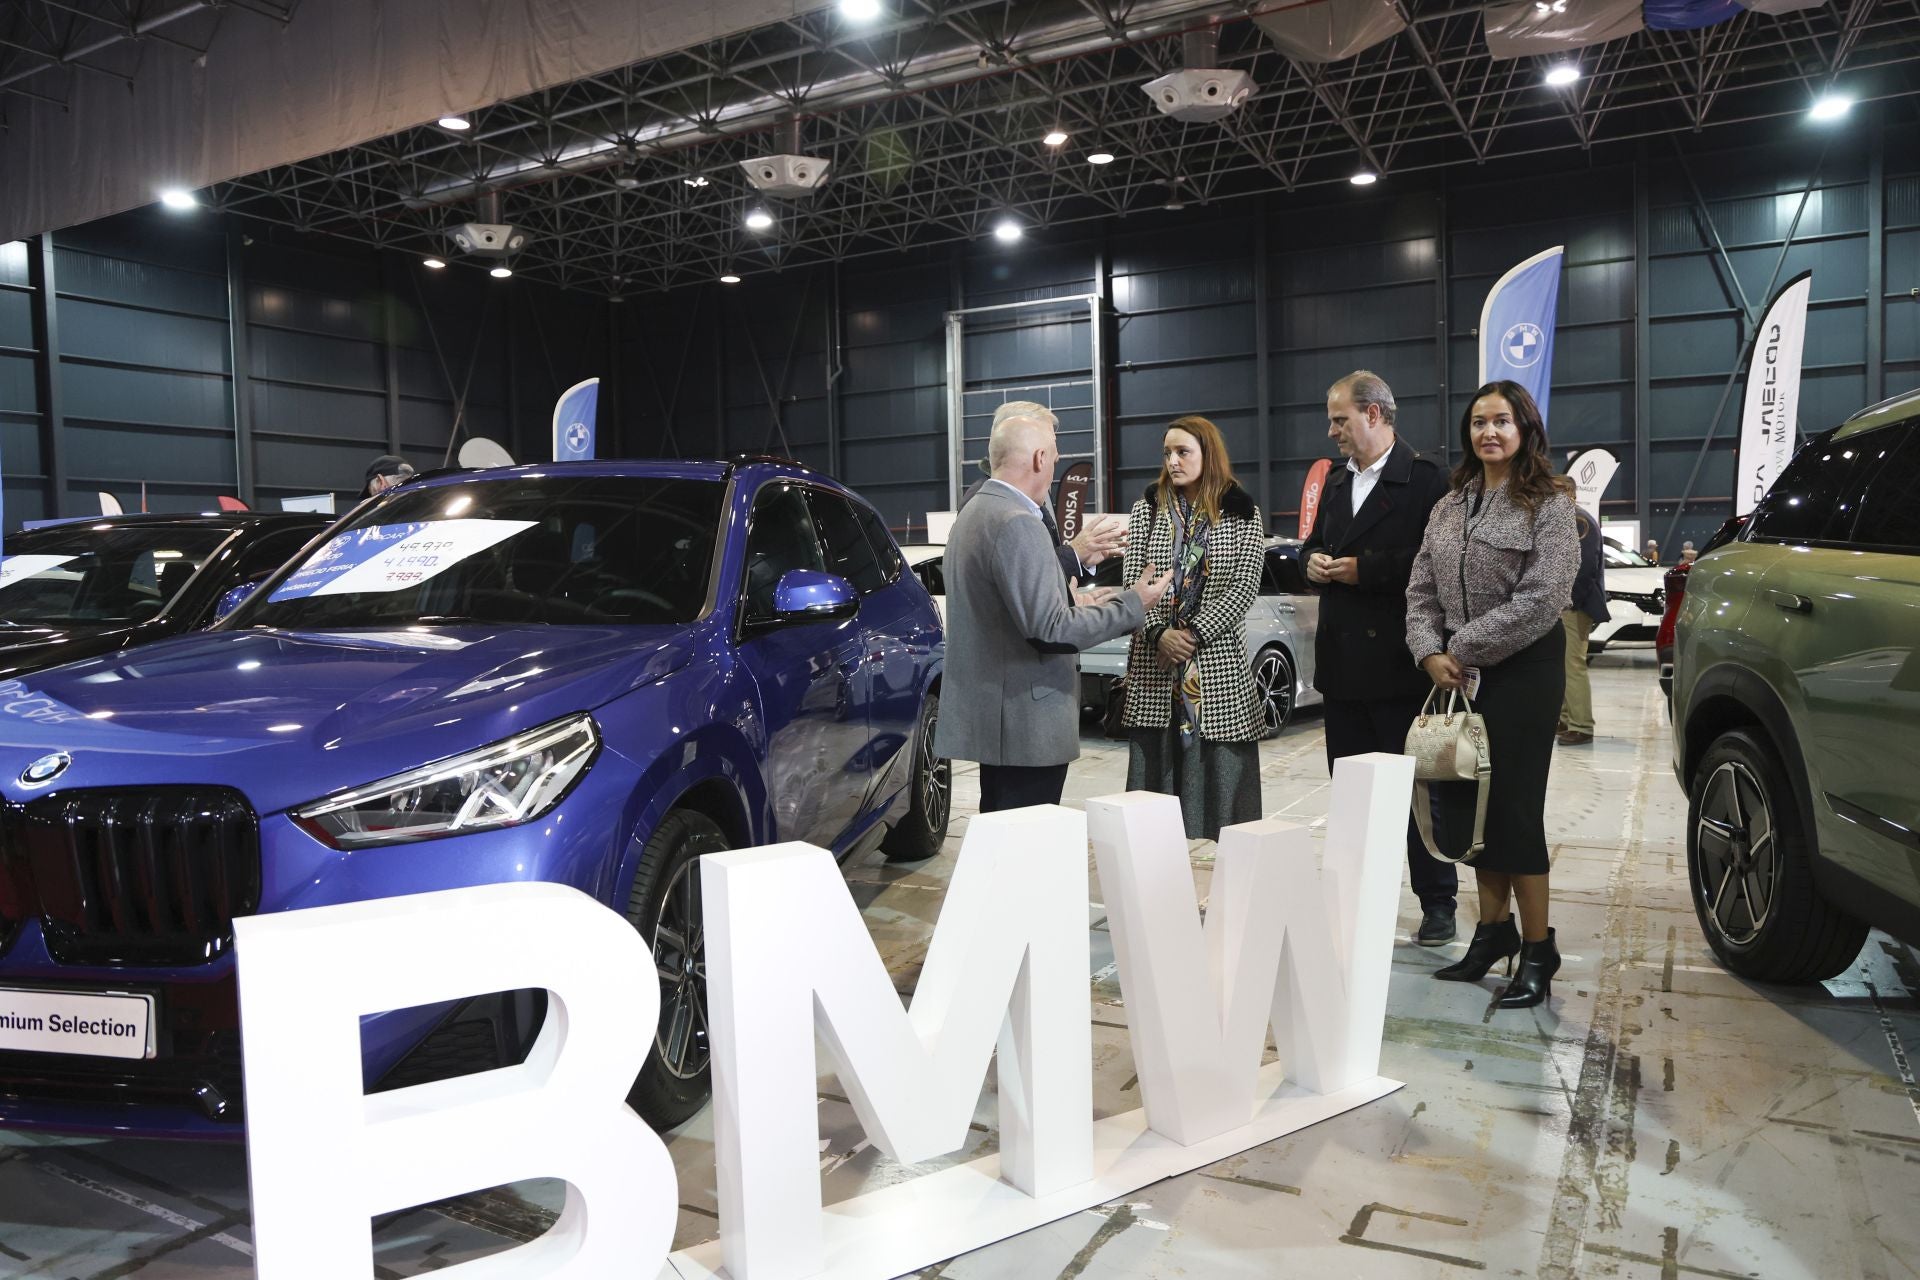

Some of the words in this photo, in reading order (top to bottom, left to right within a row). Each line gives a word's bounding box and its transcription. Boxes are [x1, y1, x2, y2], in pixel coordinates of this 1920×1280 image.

[1776, 449, 1785, 478] OVA
[48, 1013, 136, 1037] Selection
[233, 753, 1414, 1280] BMW
